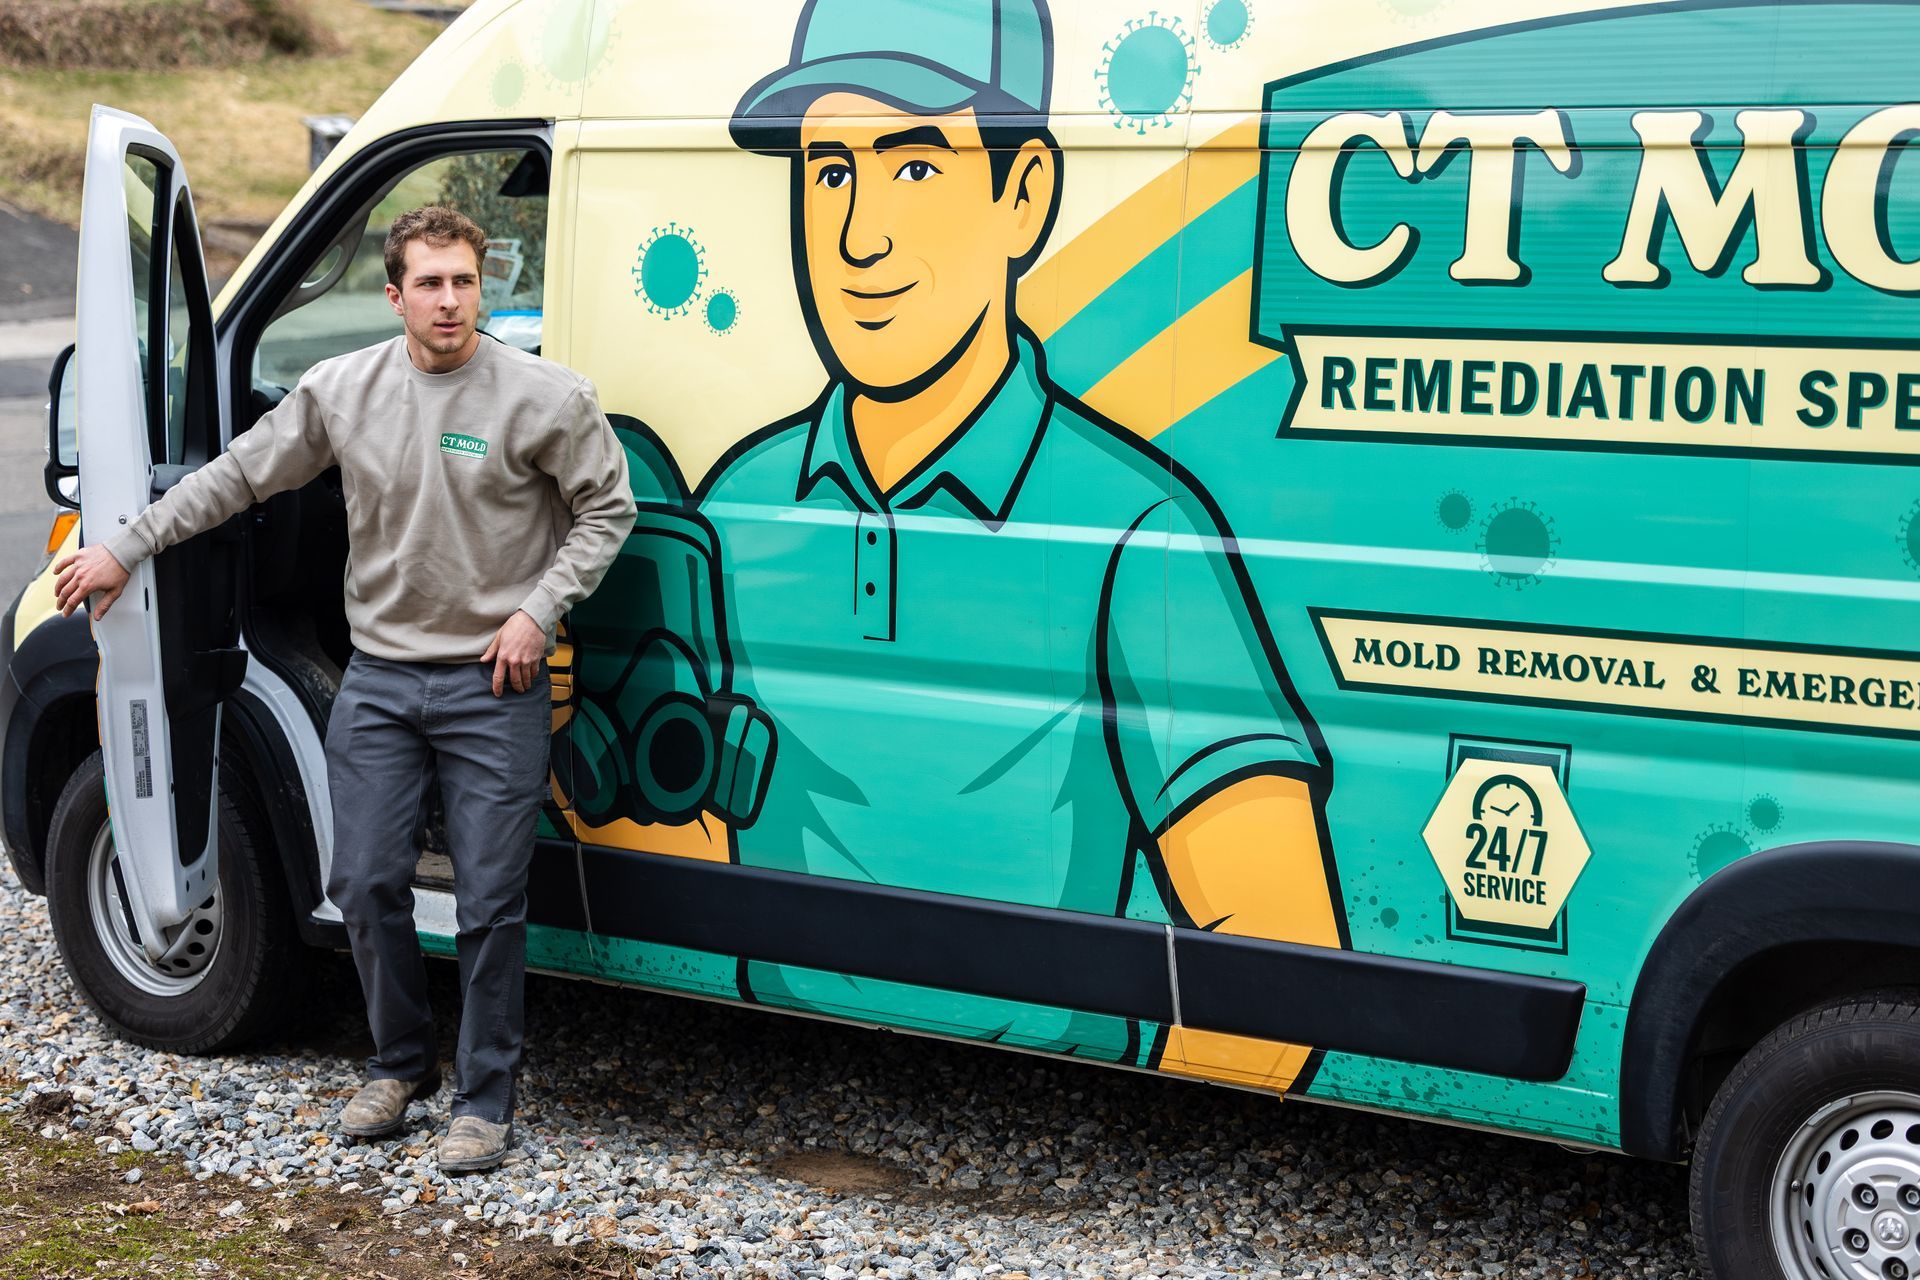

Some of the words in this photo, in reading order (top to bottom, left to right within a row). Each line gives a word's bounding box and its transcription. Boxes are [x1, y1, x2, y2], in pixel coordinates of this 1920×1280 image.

[1285, 108, 1582, 288] CT
[1321, 355, 1766, 425] REMEDIATION
[1796, 369, 1920, 432] SPE
[442, 435, 457, 447] CT
[457, 438, 486, 452] MOLD
[1352, 637, 1461, 672] MOLD
[1477, 648, 1666, 690] REMOVAL
[1691, 664, 1722, 694] &
[1737, 668, 1920, 710] EMERGE
[1464, 822, 1549, 876] 24/7
[1463, 872, 1547, 906] SERVICE
